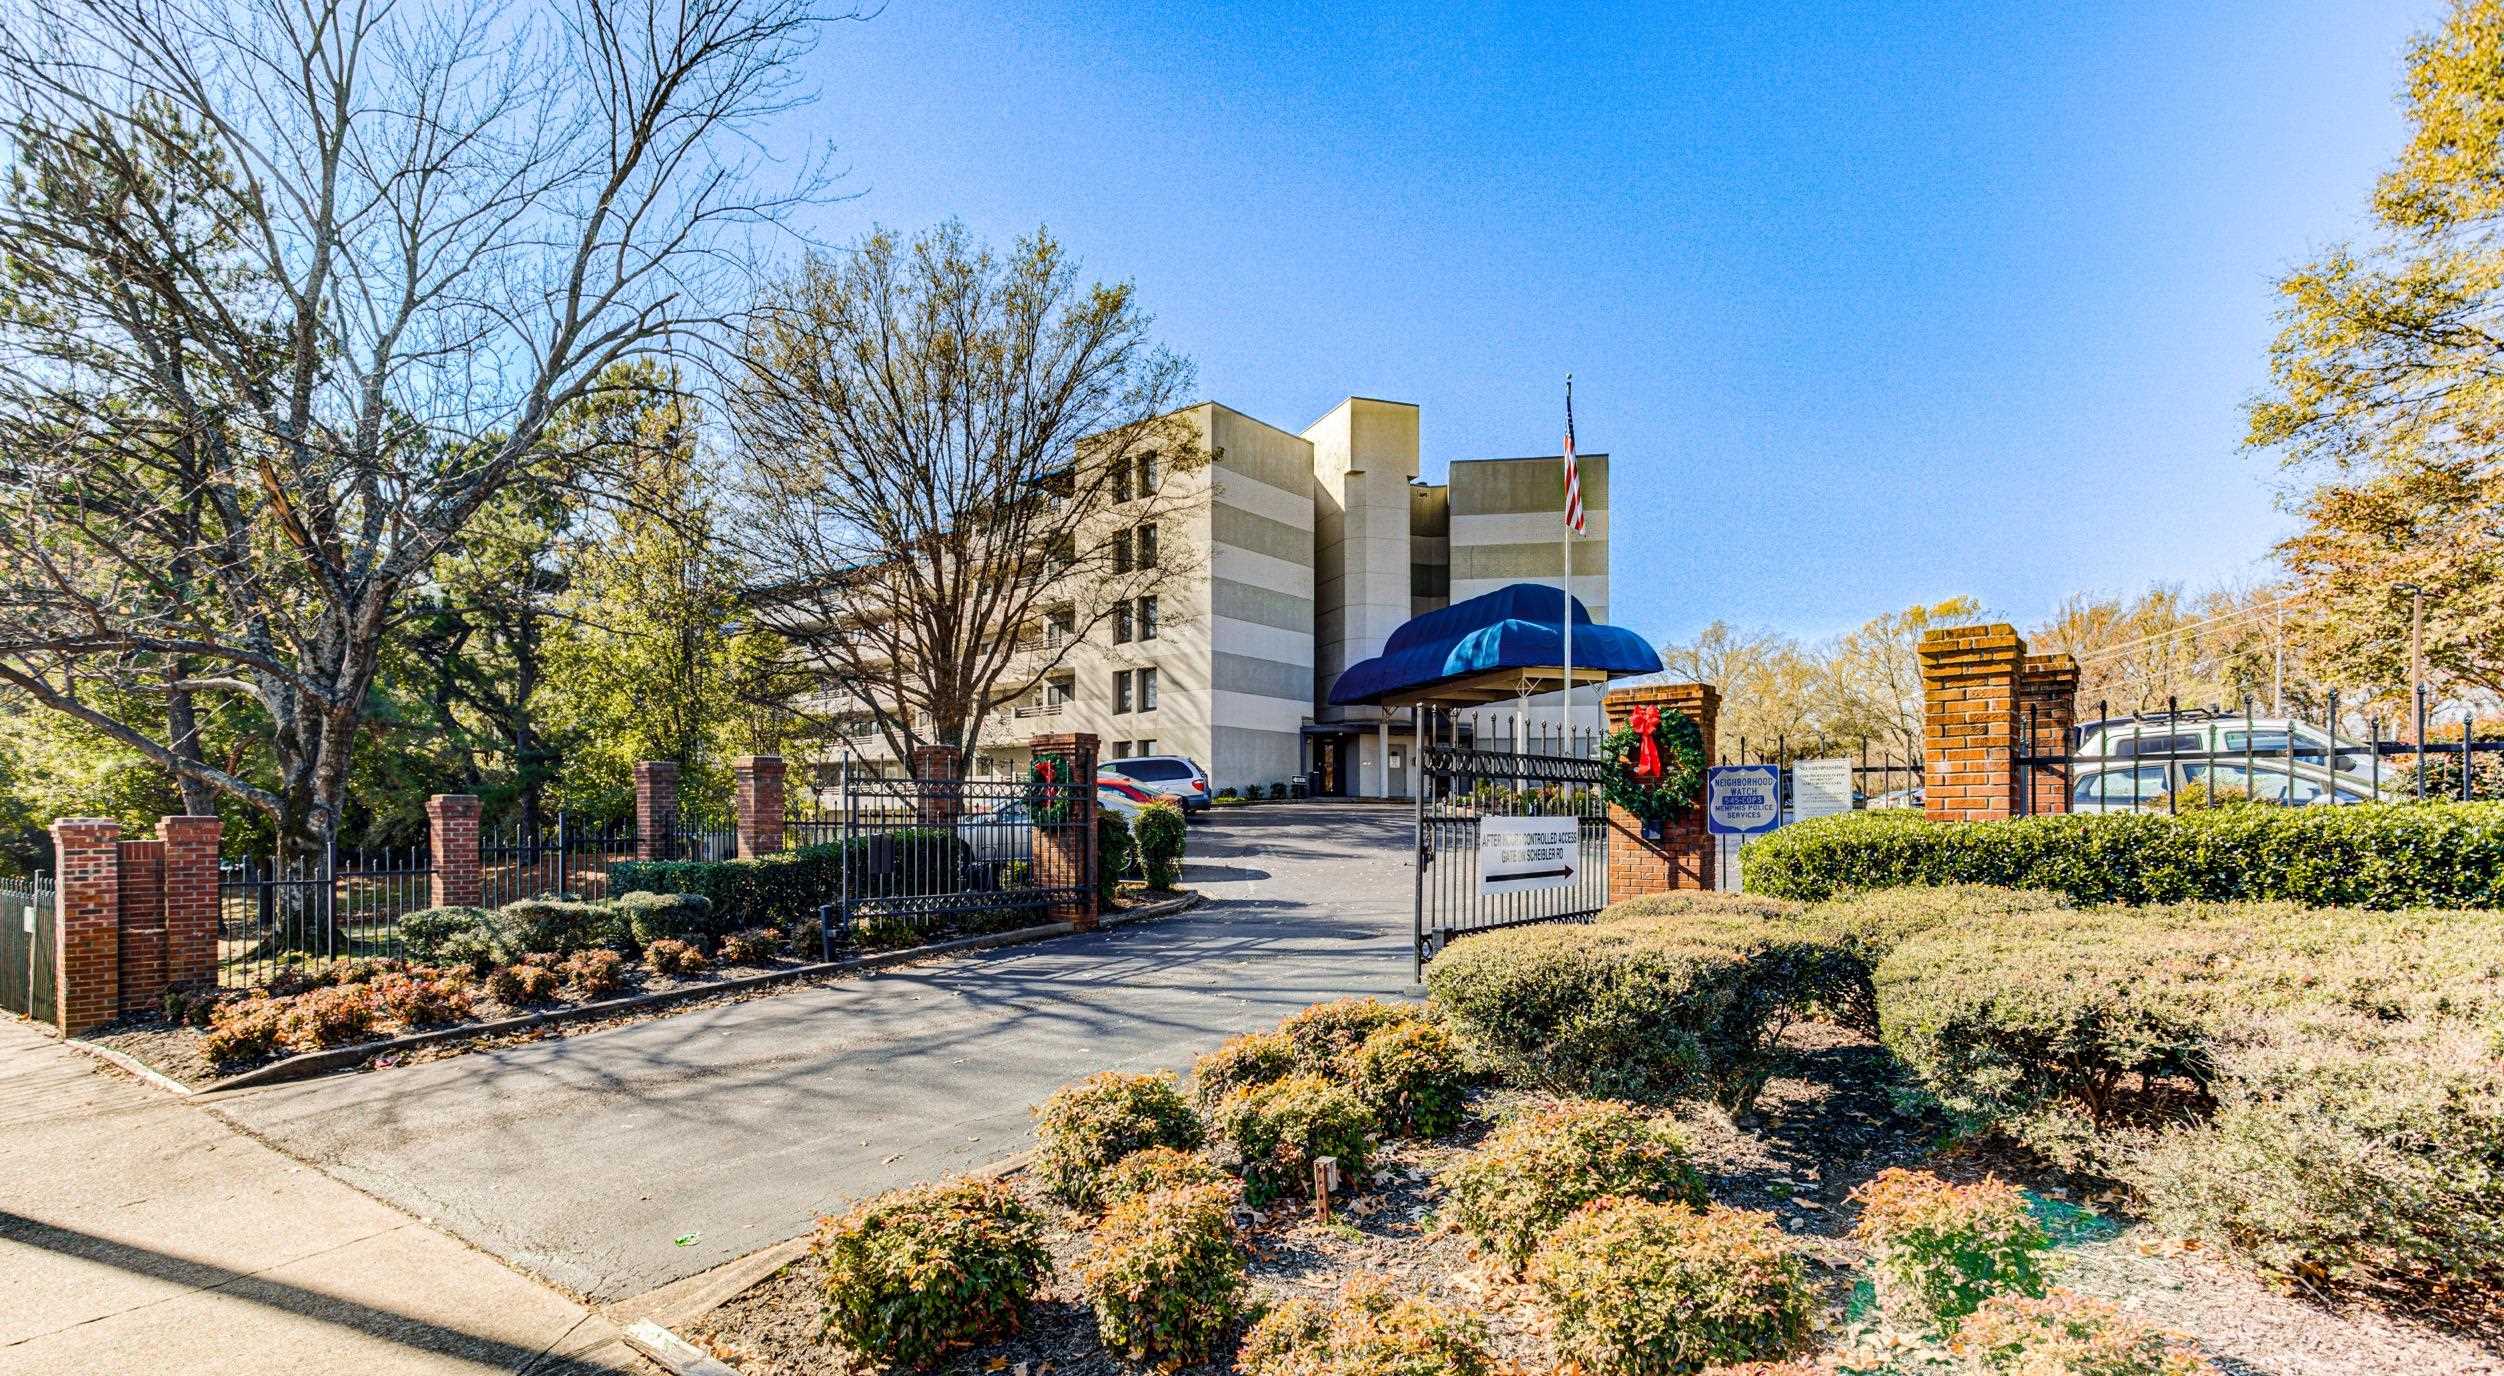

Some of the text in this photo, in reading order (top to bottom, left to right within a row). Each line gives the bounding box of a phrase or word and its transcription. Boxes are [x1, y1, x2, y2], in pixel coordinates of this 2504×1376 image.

[1715, 778, 1773, 787] NEIGHBORHOOD
[1730, 787, 1757, 796] WATCH
[1715, 804, 1746, 812] MEMPHIS
[1727, 811, 1761, 819] SERVICES
[1482, 832, 1502, 848] AFTER
[1524, 831, 1557, 846] CONTROLLED
[1558, 831, 1577, 844] ACCESS
[1501, 849, 1517, 863] GATE
[1556, 847, 1564, 860] RD
